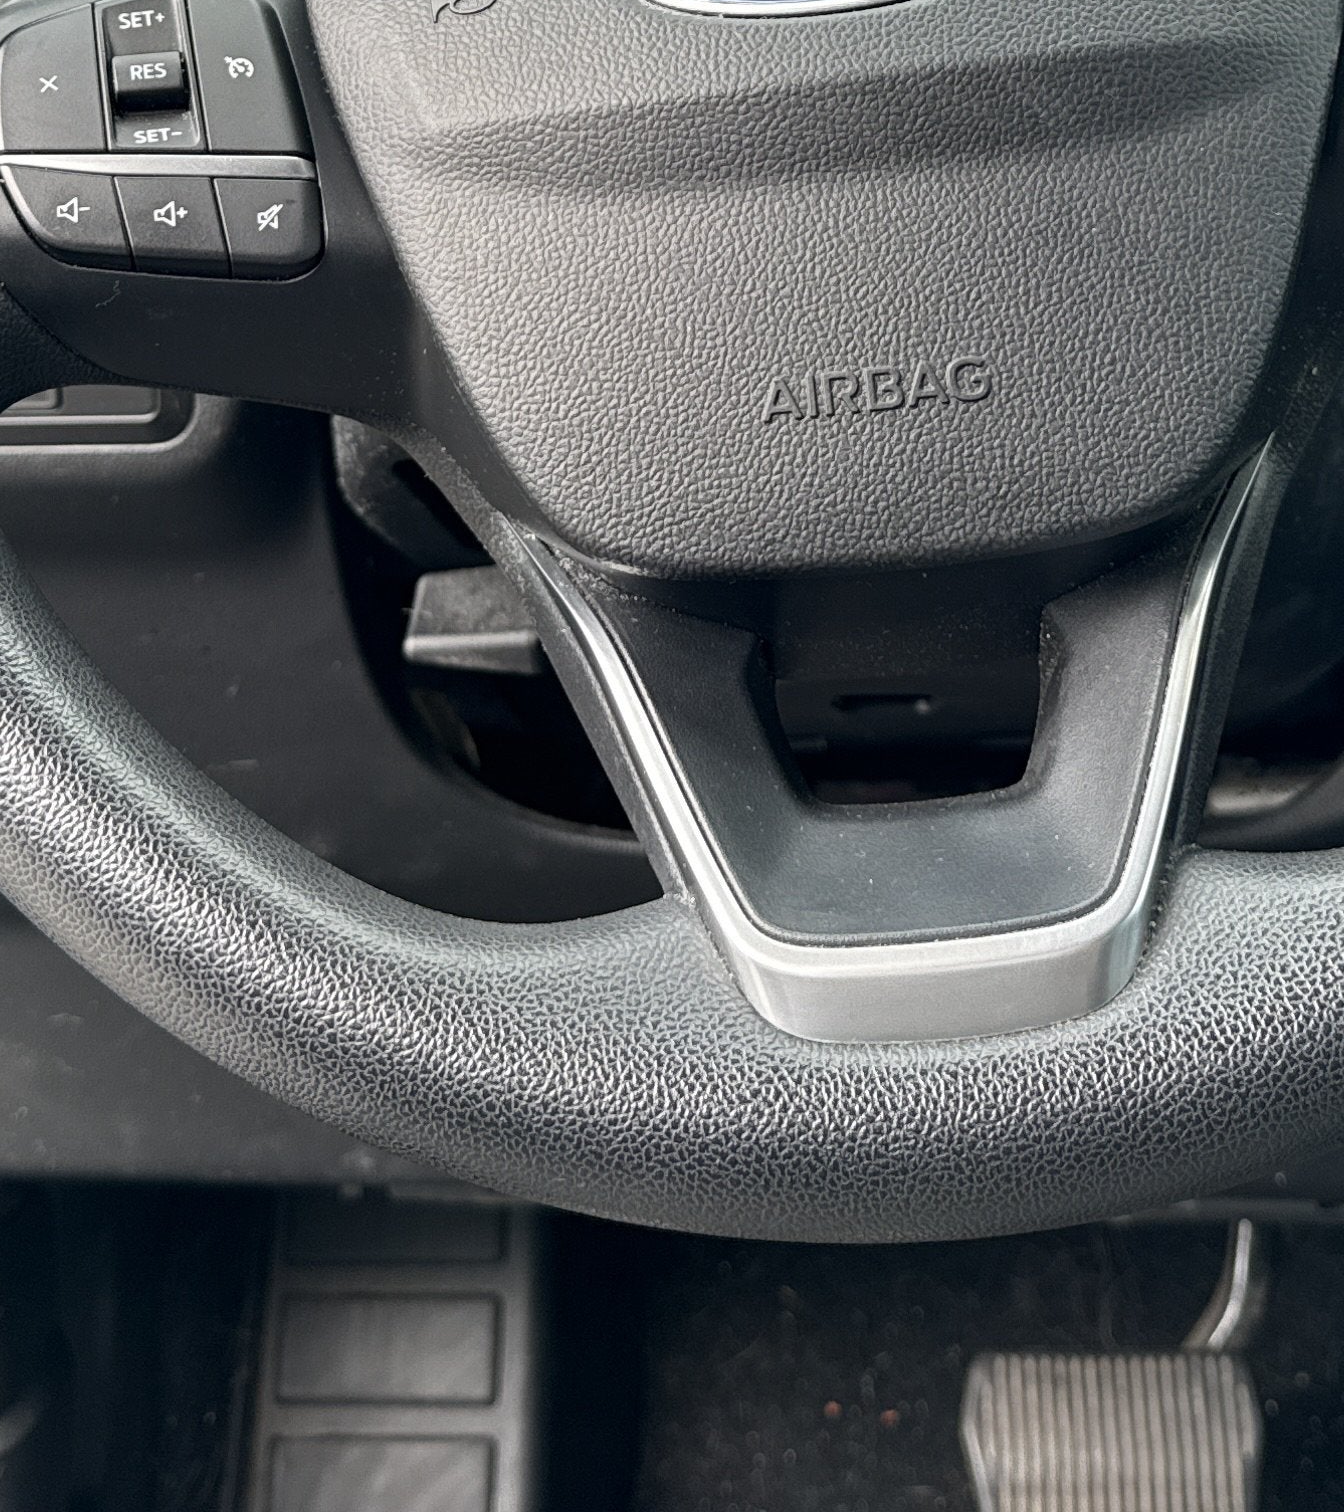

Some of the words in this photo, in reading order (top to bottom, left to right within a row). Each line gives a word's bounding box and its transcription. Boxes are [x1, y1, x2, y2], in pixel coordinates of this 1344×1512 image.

[118, 9, 166, 30] SET+
[130, 63, 168, 81] RES
[133, 126, 184, 145] SET-
[762, 354, 994, 425] AIRBAG
